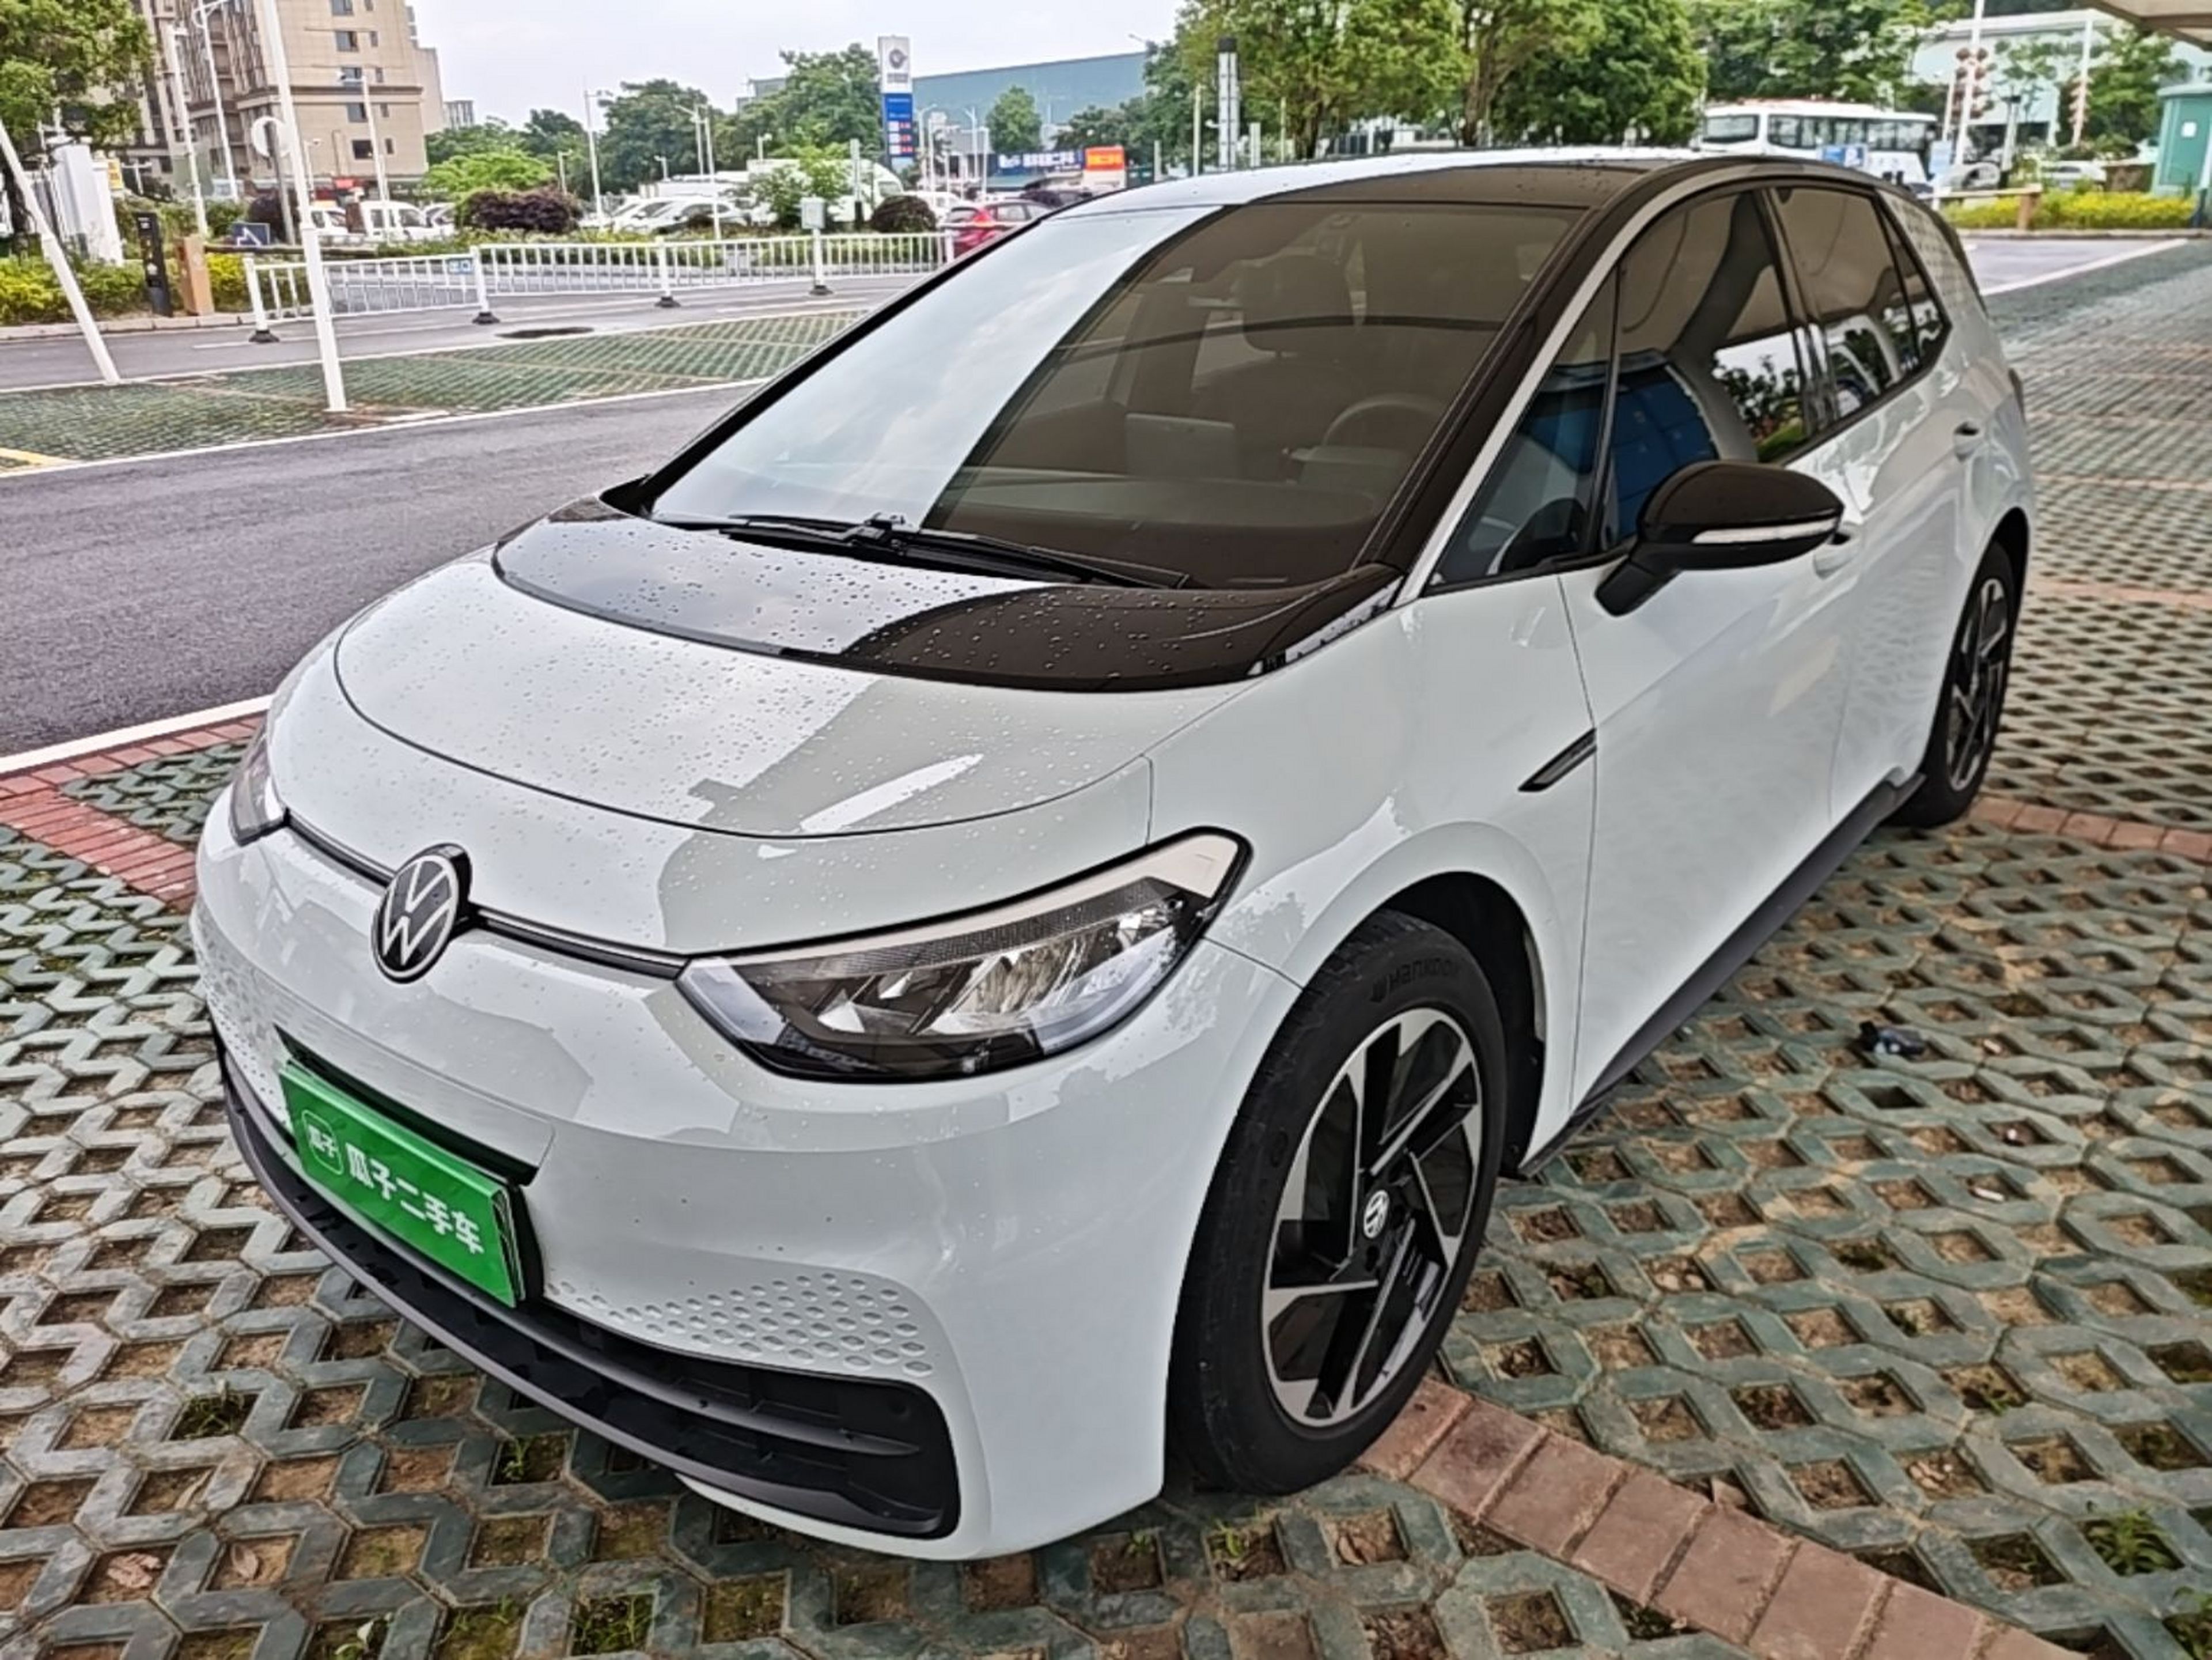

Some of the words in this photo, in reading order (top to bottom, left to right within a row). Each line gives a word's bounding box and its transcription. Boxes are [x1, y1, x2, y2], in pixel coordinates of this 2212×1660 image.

[346, 1142, 485, 1255] 瓜子二手车
